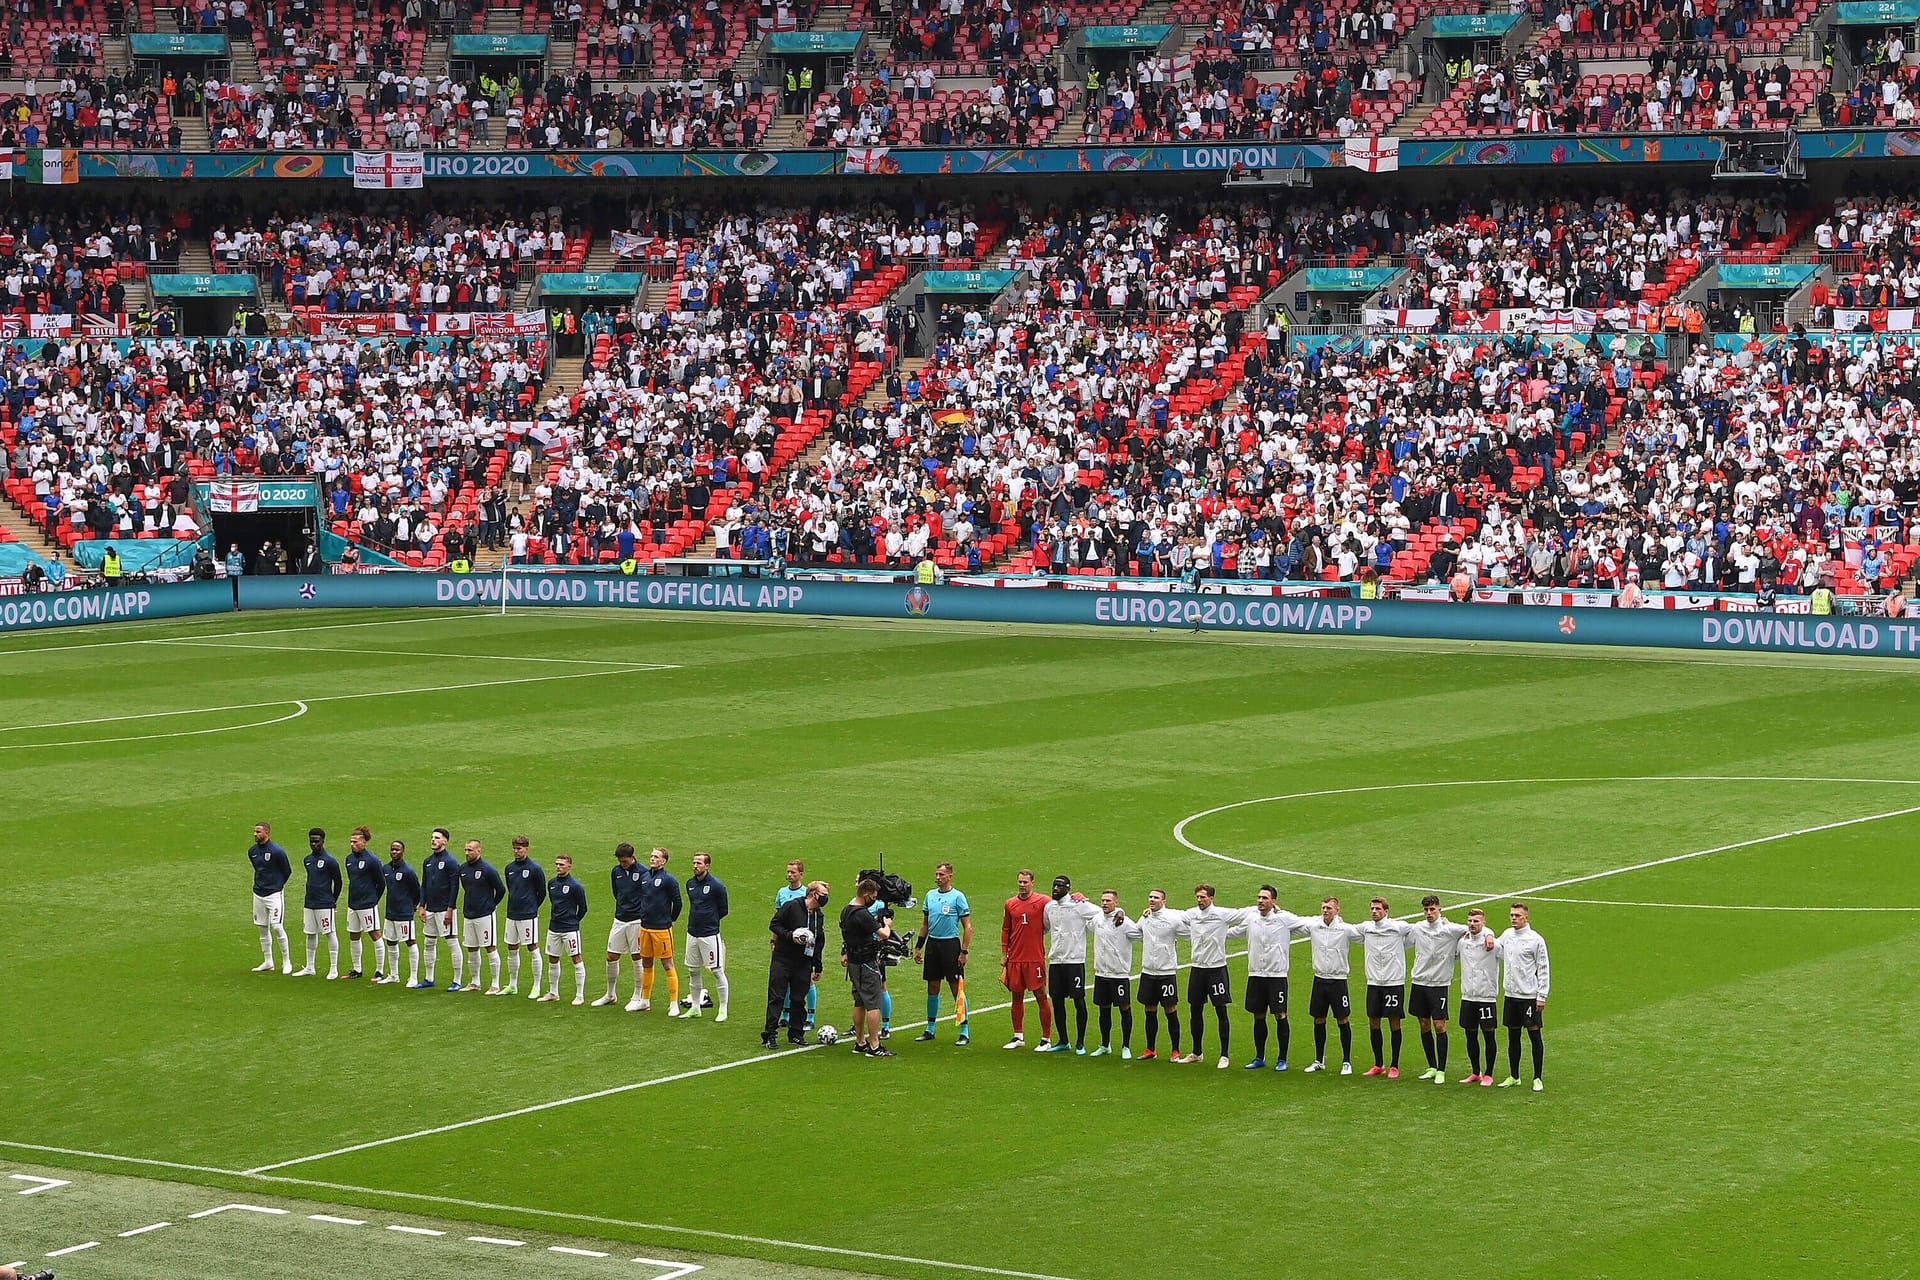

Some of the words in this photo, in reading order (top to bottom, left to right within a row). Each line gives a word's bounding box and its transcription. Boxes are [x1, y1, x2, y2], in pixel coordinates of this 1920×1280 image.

[1878, 3, 1895, 12] 224
[1471, 17, 1487, 25] 223
[810, 34, 825, 42] 221
[1123, 28, 1138, 36] 222
[169, 36, 185, 44] 219
[492, 37, 508, 45] 220
[1182, 148, 1277, 168] LONDON
[423, 156, 468, 175] URO
[472, 156, 529, 175] 2020
[965, 273, 981, 281] 118
[1348, 270, 1364, 278] 119
[1763, 267, 1780, 276] 120
[194, 277, 210, 285] 116
[585, 275, 600, 283] 117
[90, 327, 118, 336] BOLTON
[519, 324, 541, 333] RAMS
[272, 489, 306, 501] 2020
[437, 578, 587, 602] DOWNLOAD
[594, 580, 639, 603] THE
[646, 580, 750, 608] OFFICIAL
[757, 585, 803, 609] APP
[0, 590, 150, 627] 020.COM/APP
[1095, 597, 1371, 630] EURO2020.COM/APP
[1702, 617, 1879, 650] DOWNLOAD
[1021, 913, 1028, 925] 1
[484, 930, 489, 940] 3
[568, 939, 577, 949] 12
[1036, 966, 1042, 978] 1
[1074, 976, 1081, 988] 2
[1117, 984, 1125, 997] 6
[1161, 983, 1175, 997] 20
[1211, 982, 1226, 996] 18
[1278, 991, 1285, 1004] 5
[1342, 995, 1349, 1008] 8
[1384, 994, 1399, 1008] 25
[1440, 997, 1446, 1010] 7
[1479, 1007, 1493, 1020] 11
[1525, 1005, 1533, 1018] 4
